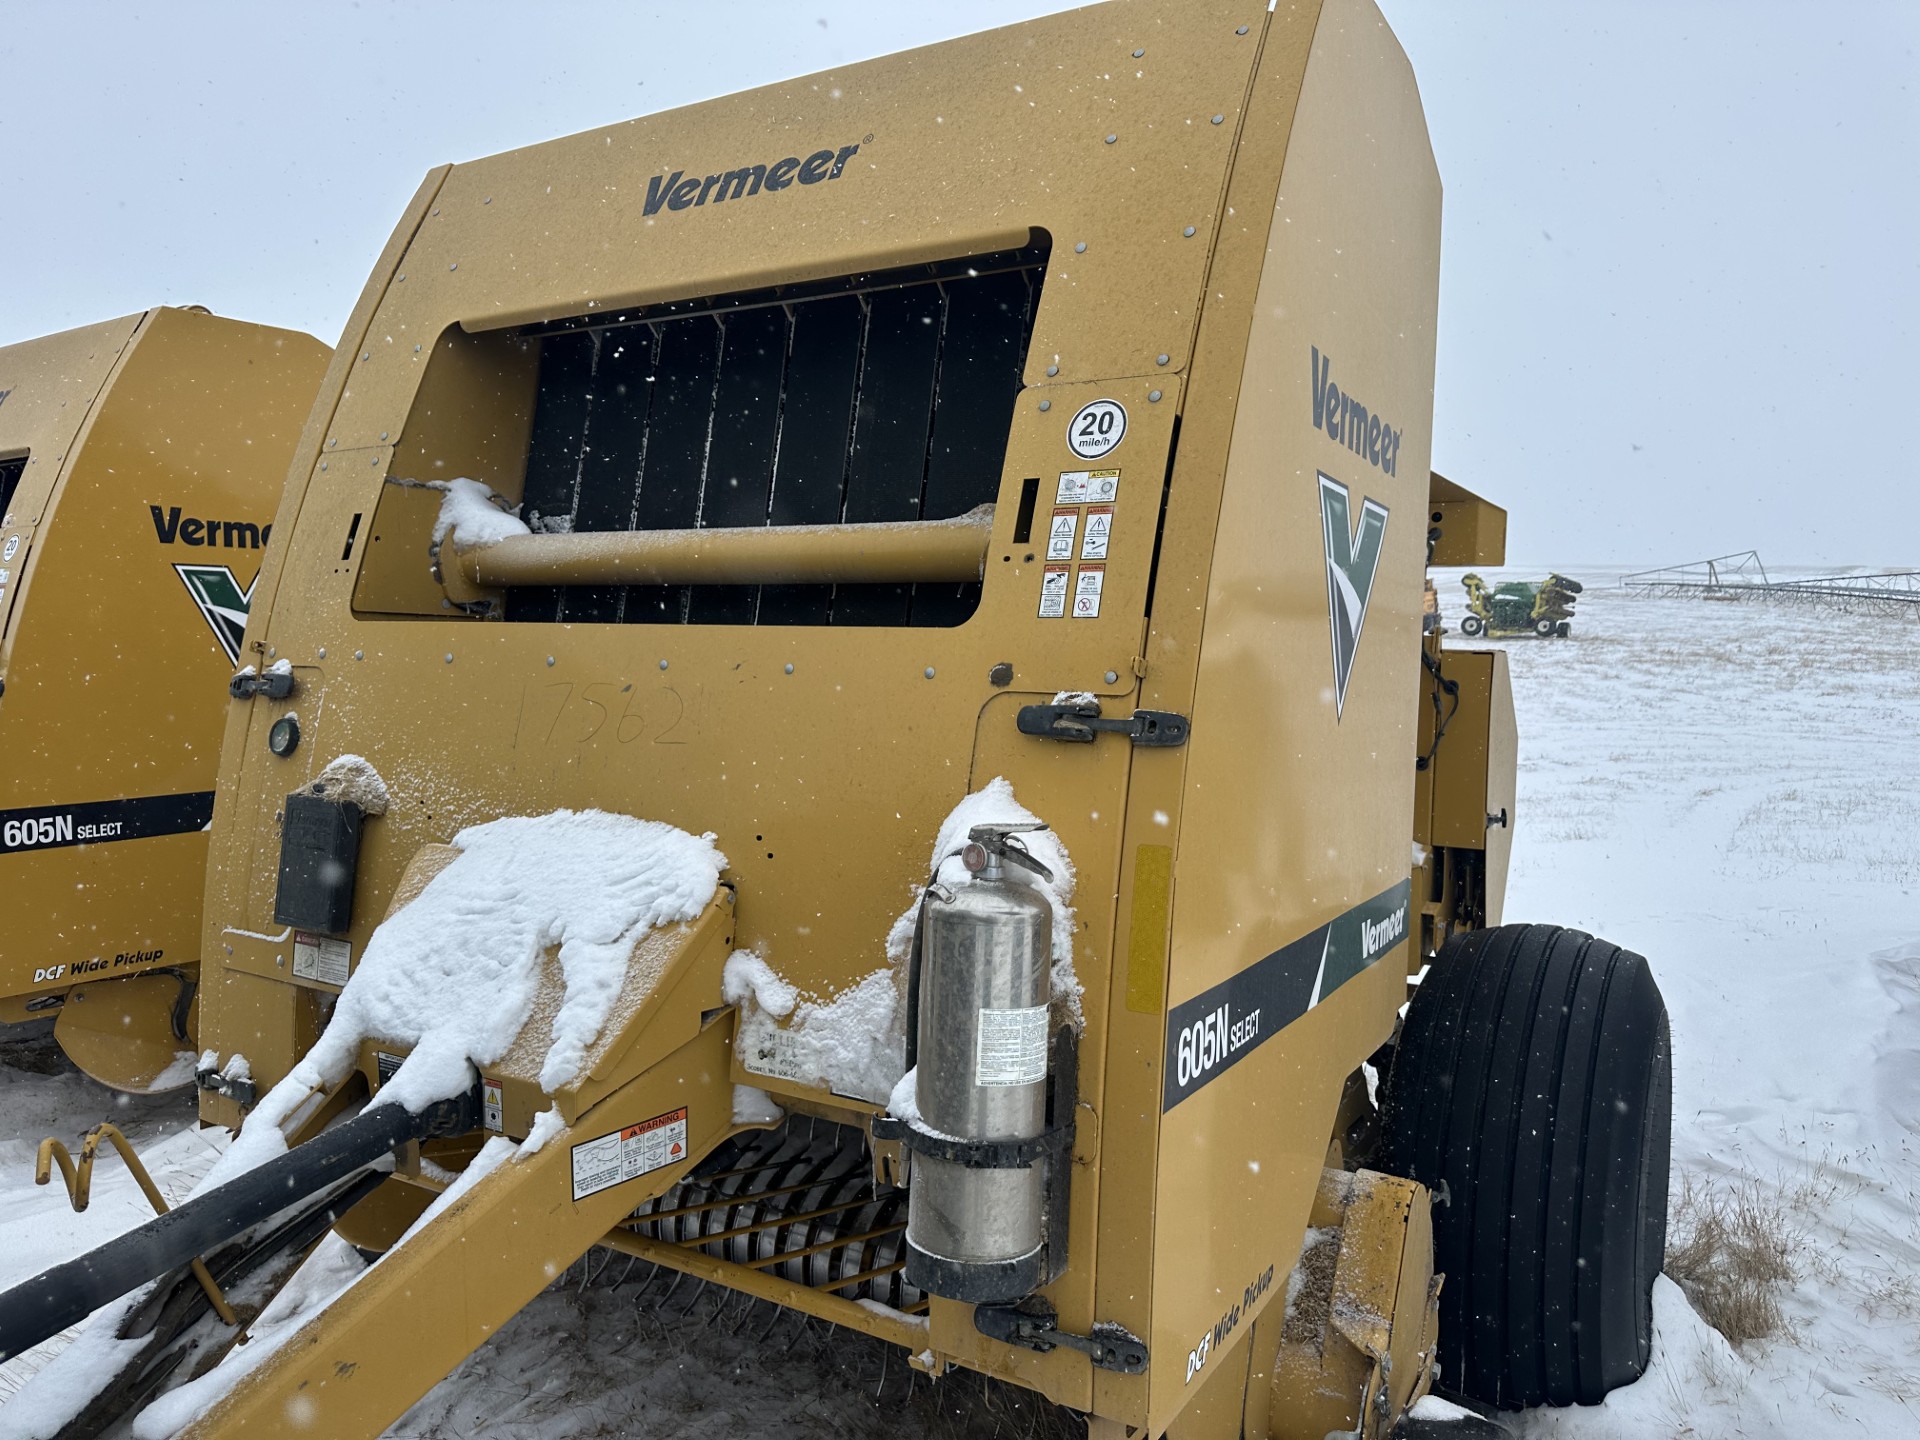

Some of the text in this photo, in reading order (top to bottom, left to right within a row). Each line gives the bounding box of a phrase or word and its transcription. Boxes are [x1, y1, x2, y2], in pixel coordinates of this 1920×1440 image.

[642, 144, 860, 217] Vermeer
[1078, 411, 1114, 436] 20
[1311, 344, 1401, 478] Vermeer
[1079, 437, 1110, 447] mile/h
[512, 682, 688, 749] 17562
[4, 814, 122, 847] 605N SELECT
[1361, 906, 1406, 960] Vermeer
[33, 949, 163, 983] DCF Wide Pickup
[1177, 1003, 1260, 1088] 605N SELECT
[638, 1112, 680, 1133] WARNING
[1185, 1263, 1274, 1386] DCF Wide Pickup
